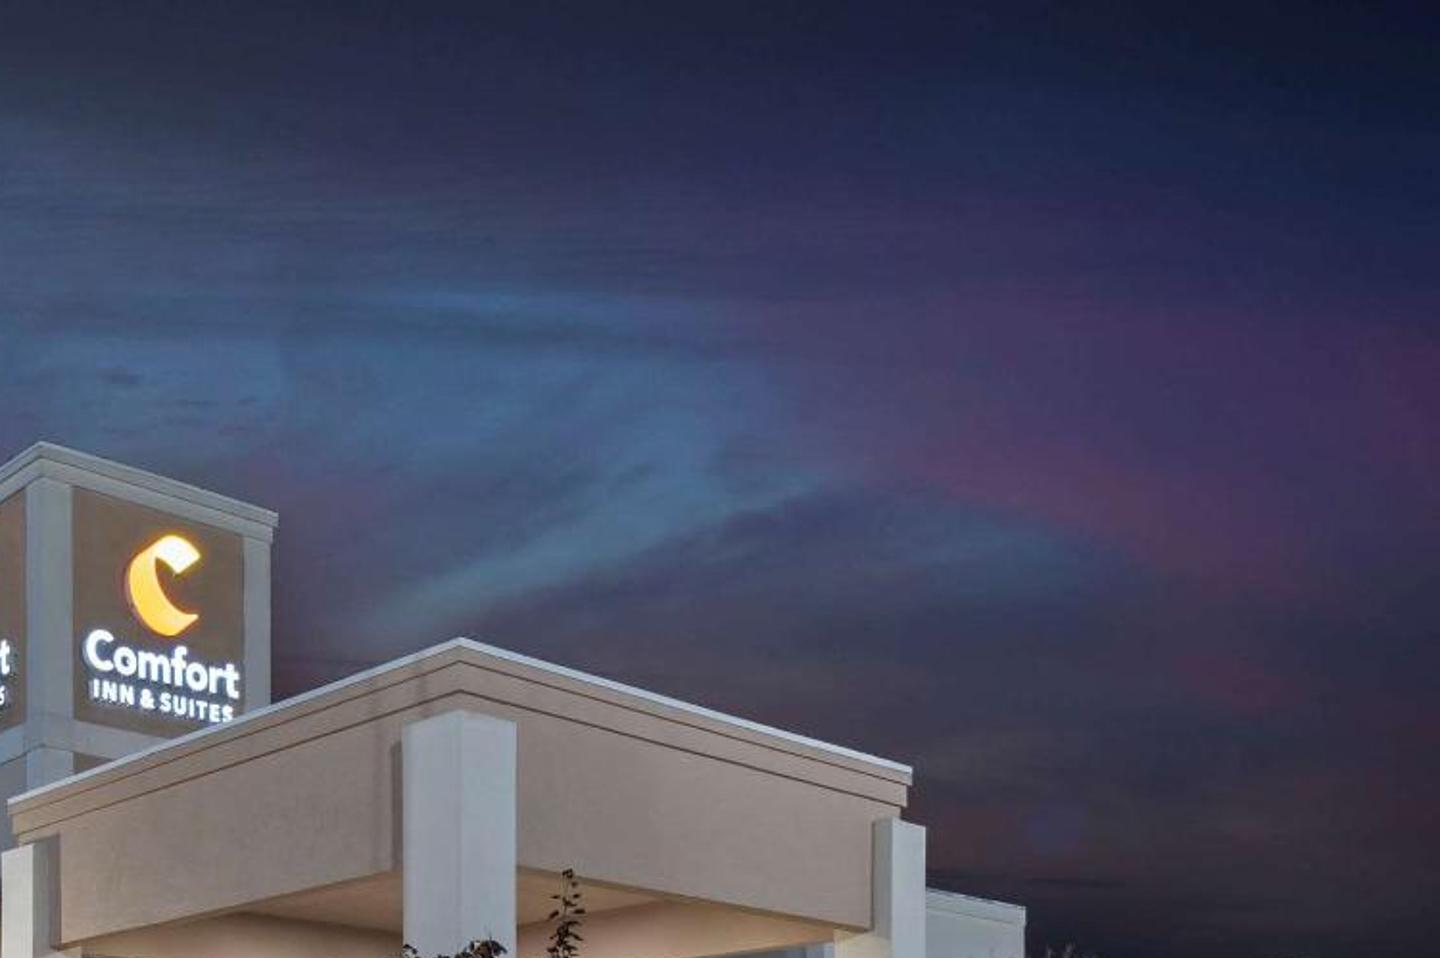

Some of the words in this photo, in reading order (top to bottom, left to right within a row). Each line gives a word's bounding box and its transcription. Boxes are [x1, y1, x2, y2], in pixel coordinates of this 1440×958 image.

[85, 629, 240, 699] Comfort
[92, 678, 135, 706] INN
[139, 688, 156, 710] &
[160, 691, 234, 723] SUITES
